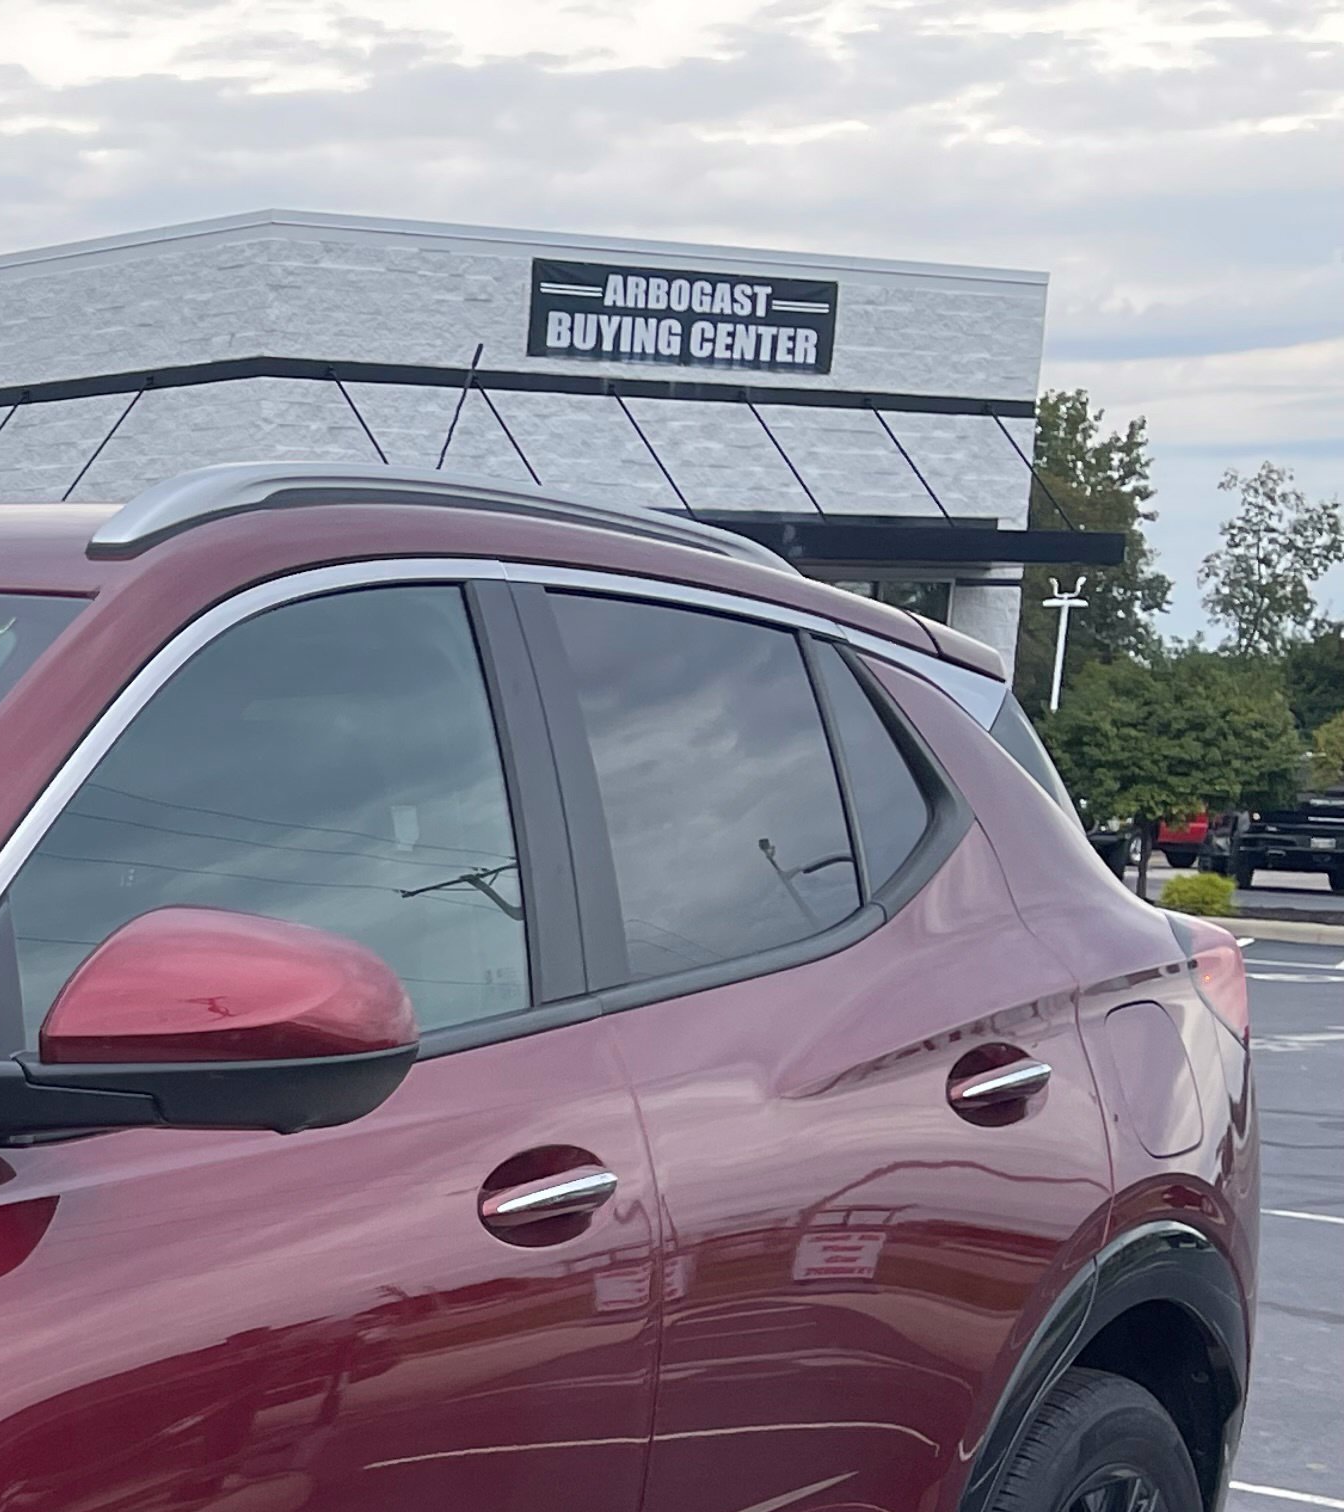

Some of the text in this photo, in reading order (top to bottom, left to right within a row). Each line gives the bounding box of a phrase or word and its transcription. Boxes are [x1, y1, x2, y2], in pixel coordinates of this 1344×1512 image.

[603, 273, 773, 318] ARBOGAST
[545, 310, 818, 365] BUYING CENTER
